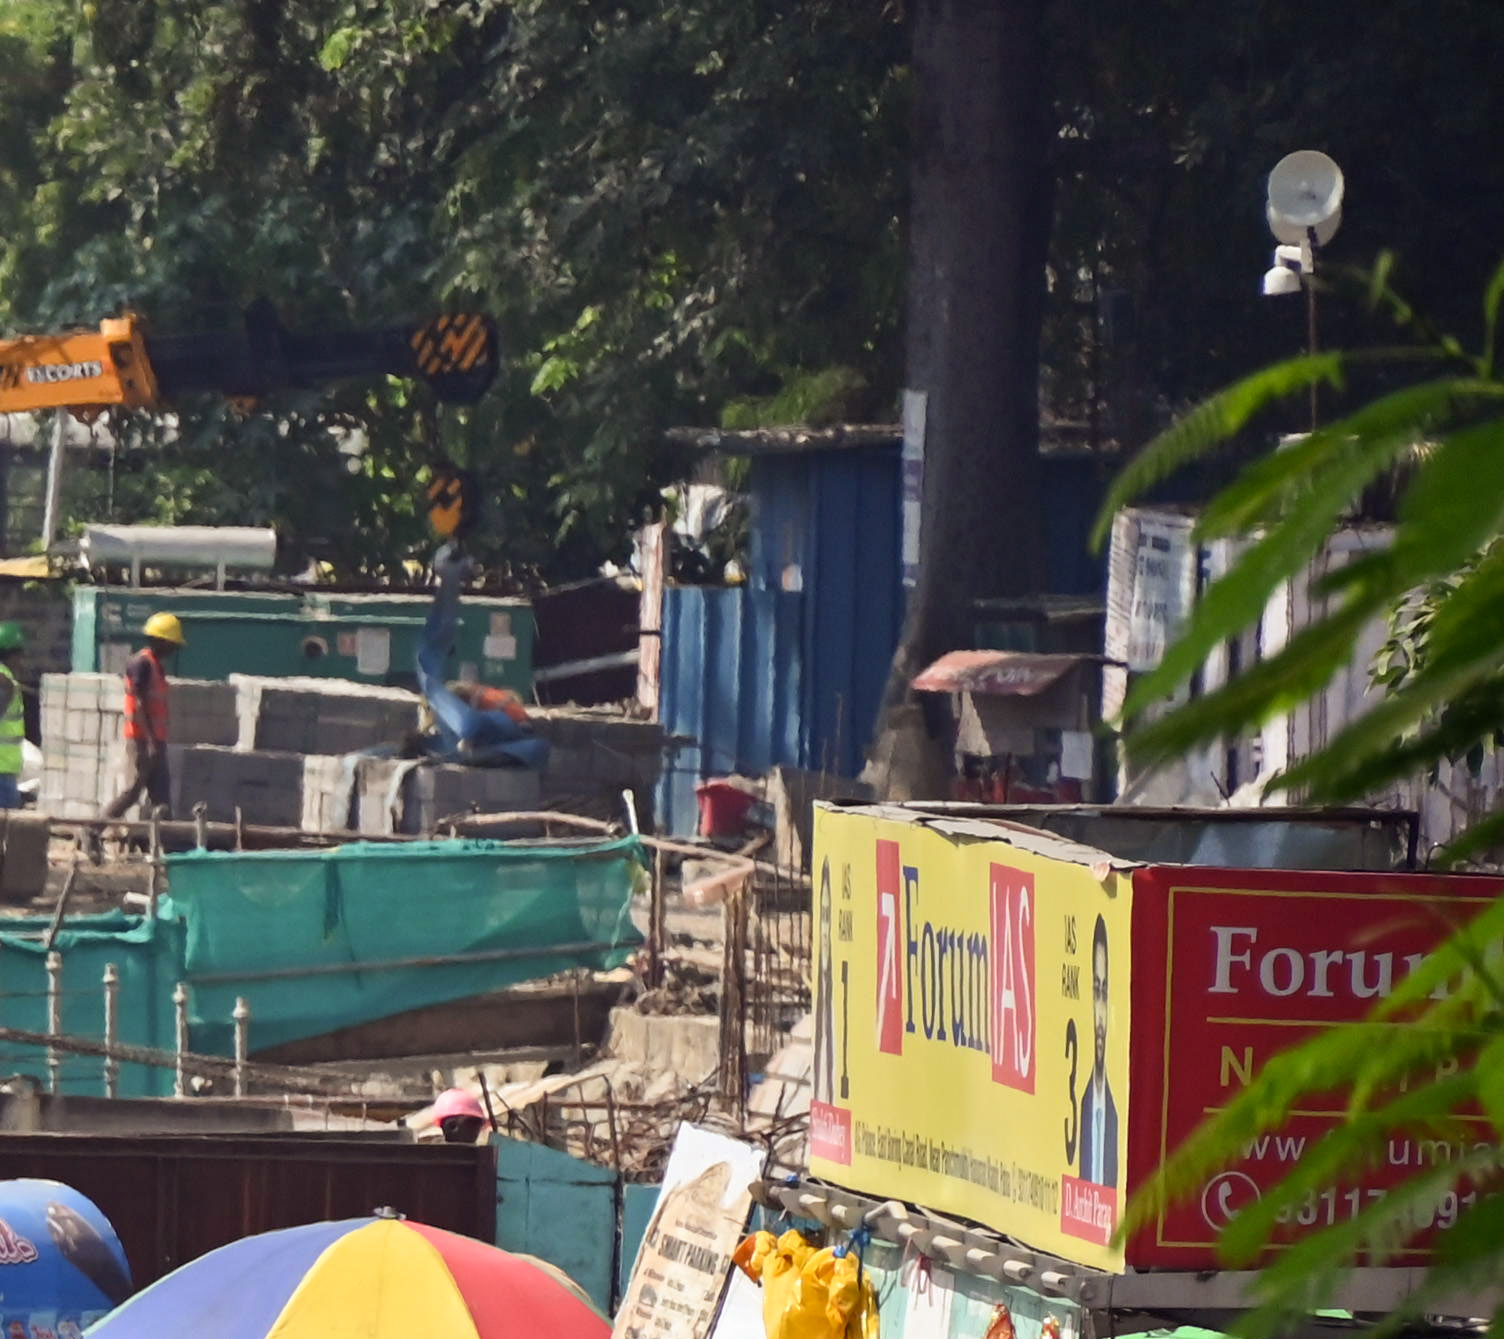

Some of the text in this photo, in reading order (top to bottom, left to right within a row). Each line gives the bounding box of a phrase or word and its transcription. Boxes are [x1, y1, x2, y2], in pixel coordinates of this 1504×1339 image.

[1064, 913, 1077, 956] IAS
[1061, 962, 1080, 1001] RANK
[1064, 1018, 1078, 1167] 3
